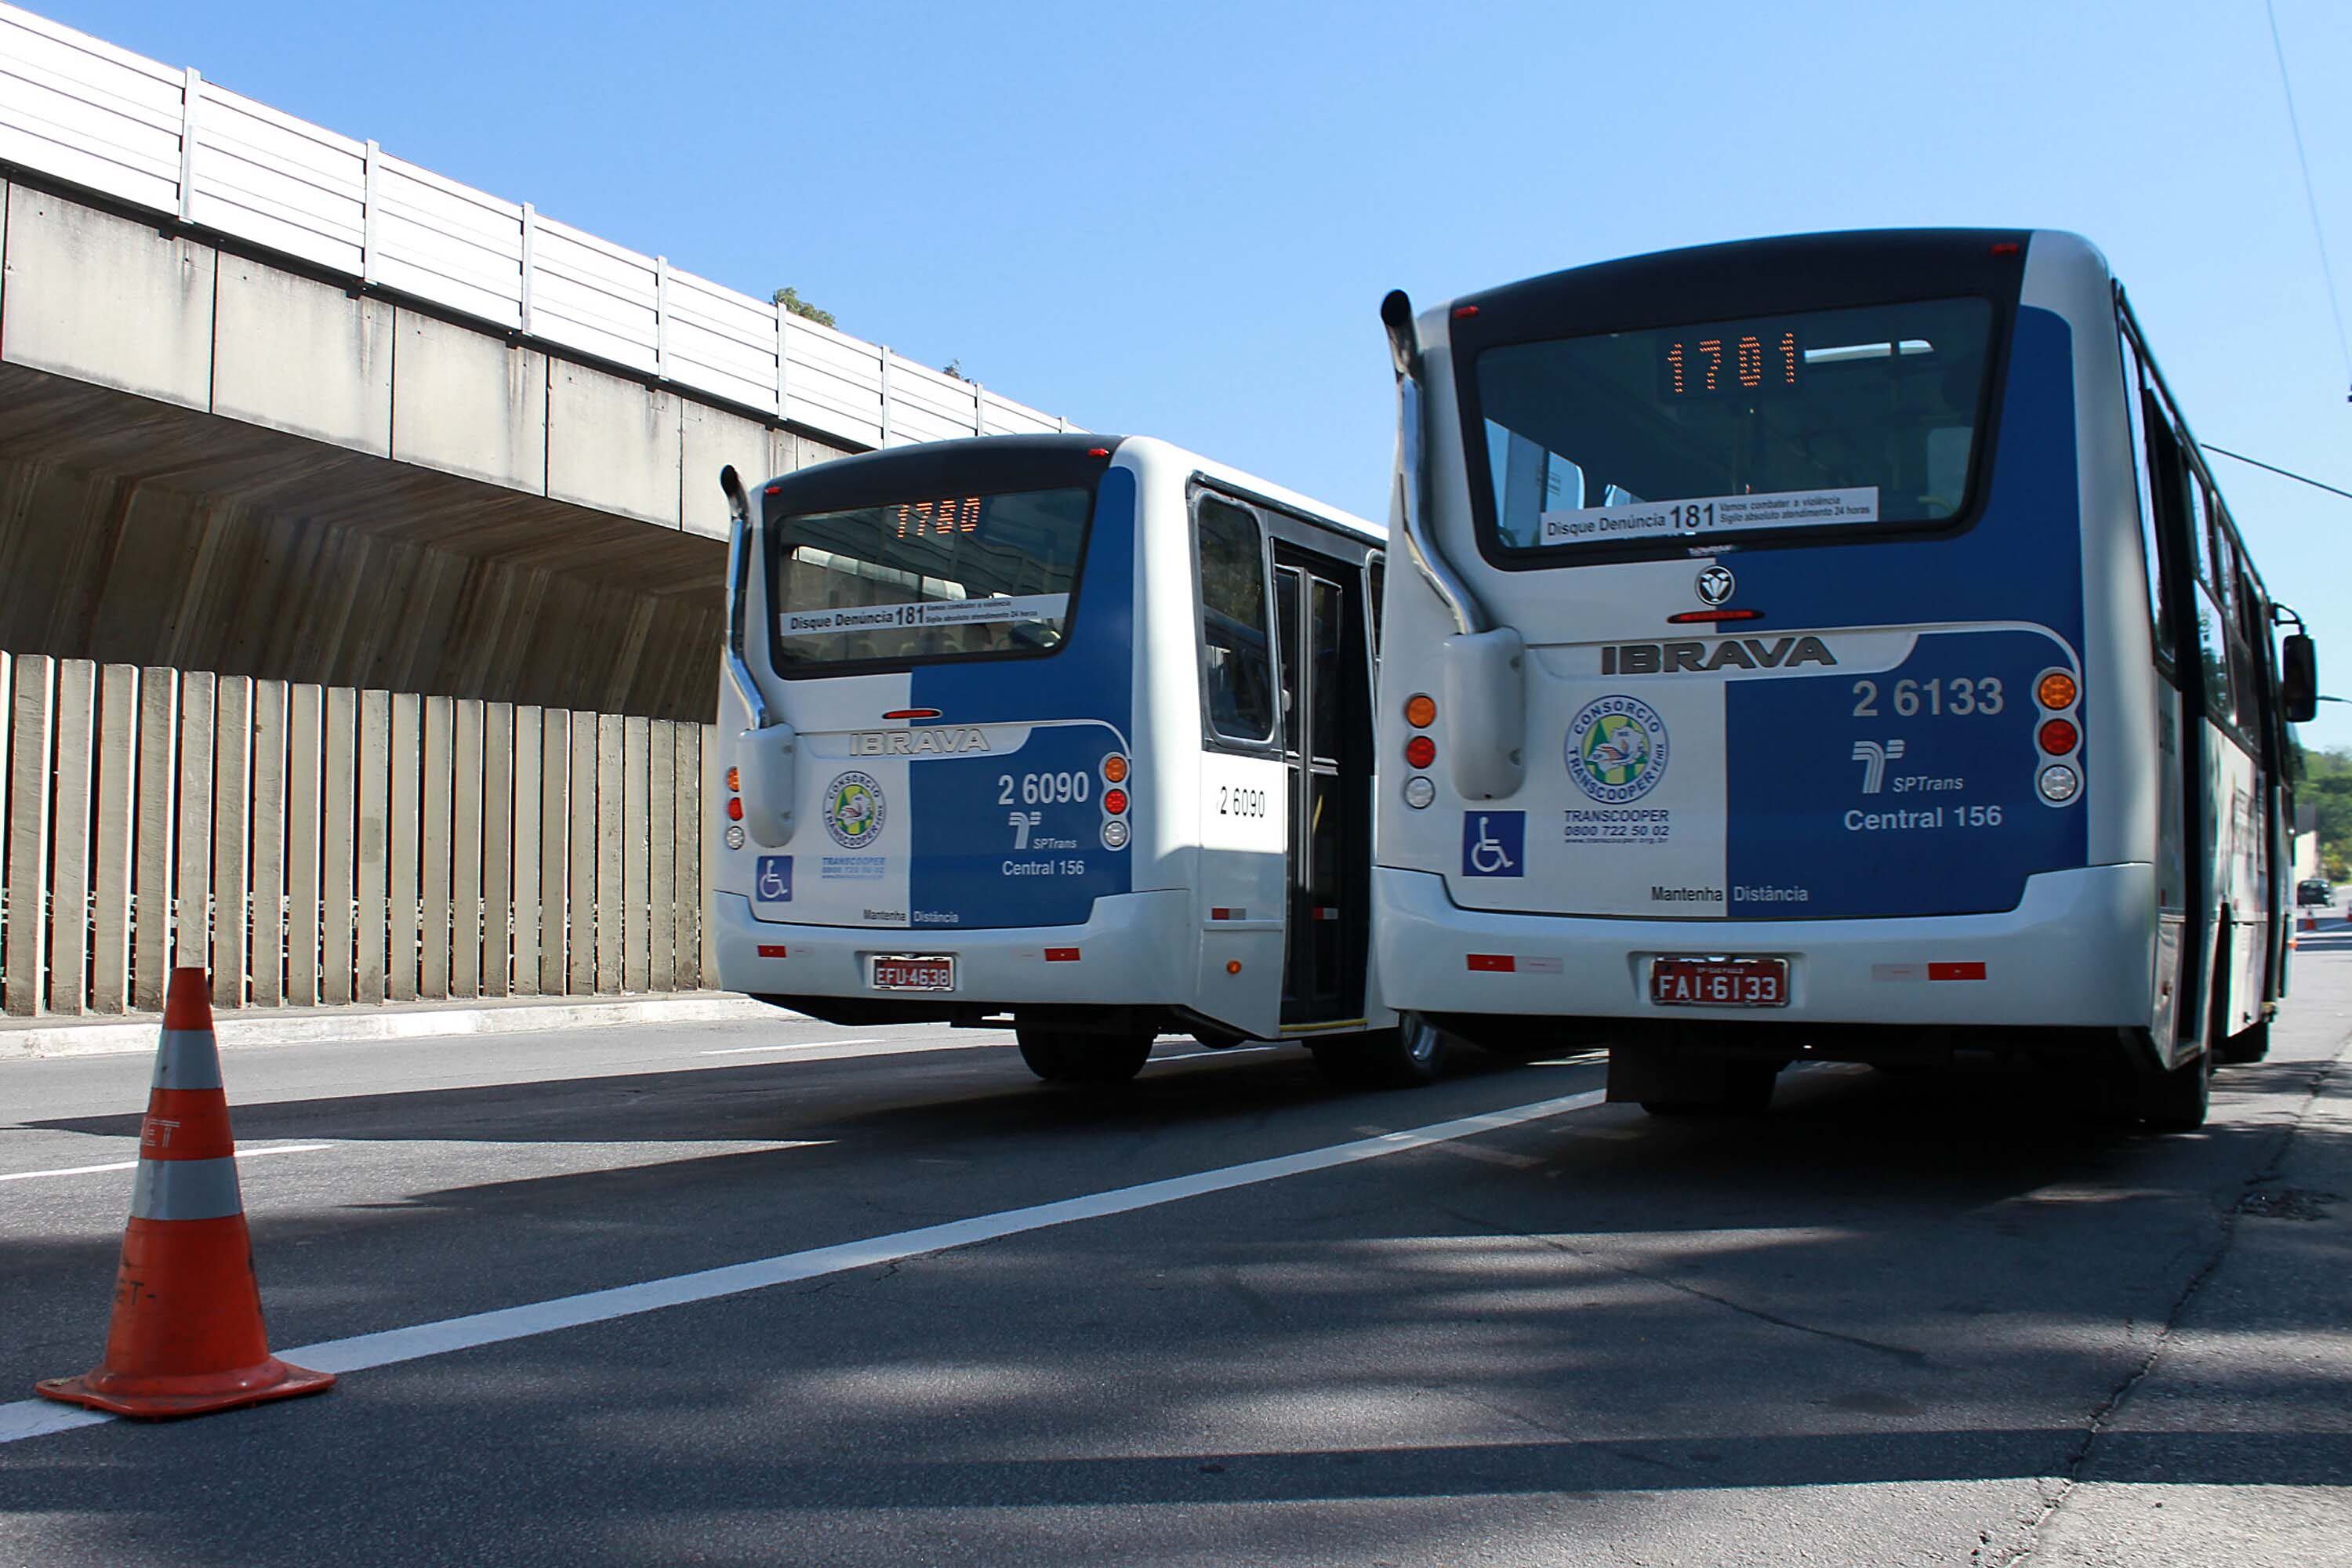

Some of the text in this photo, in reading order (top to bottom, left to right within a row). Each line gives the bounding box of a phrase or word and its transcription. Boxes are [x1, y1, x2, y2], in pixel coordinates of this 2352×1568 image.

[1668, 332, 1795, 393] 1701
[897, 498, 980, 537] 1780
[1547, 503, 1714, 536] Disque Denúncia 181
[790, 605, 924, 630] Disque Denúncia 181
[1601, 636, 1838, 676] IBRAVA
[1853, 677, 2004, 717] 2 6133
[1574, 700, 1661, 735] CONSORCIO
[849, 728, 990, 757] IBRAVA
[1022, 771, 1089, 804] 6090
[1569, 746, 1656, 800] TRANSCOOPER
[1893, 775, 1963, 793] SPTrans
[1233, 787, 1265, 818] 6090
[1565, 809, 1669, 822] TRANSCOOPER
[1602, 826, 1627, 837] 722
[1632, 826, 1646, 837] 50
[1652, 826, 1669, 837] 02
[1844, 805, 2002, 831] Central 156
[1032, 837, 1077, 850] SPTrans
[1002, 860, 1085, 876] Central 156
[1651, 885, 1809, 902] Mantenha Distância
[864, 909, 906, 921] Mantenha
